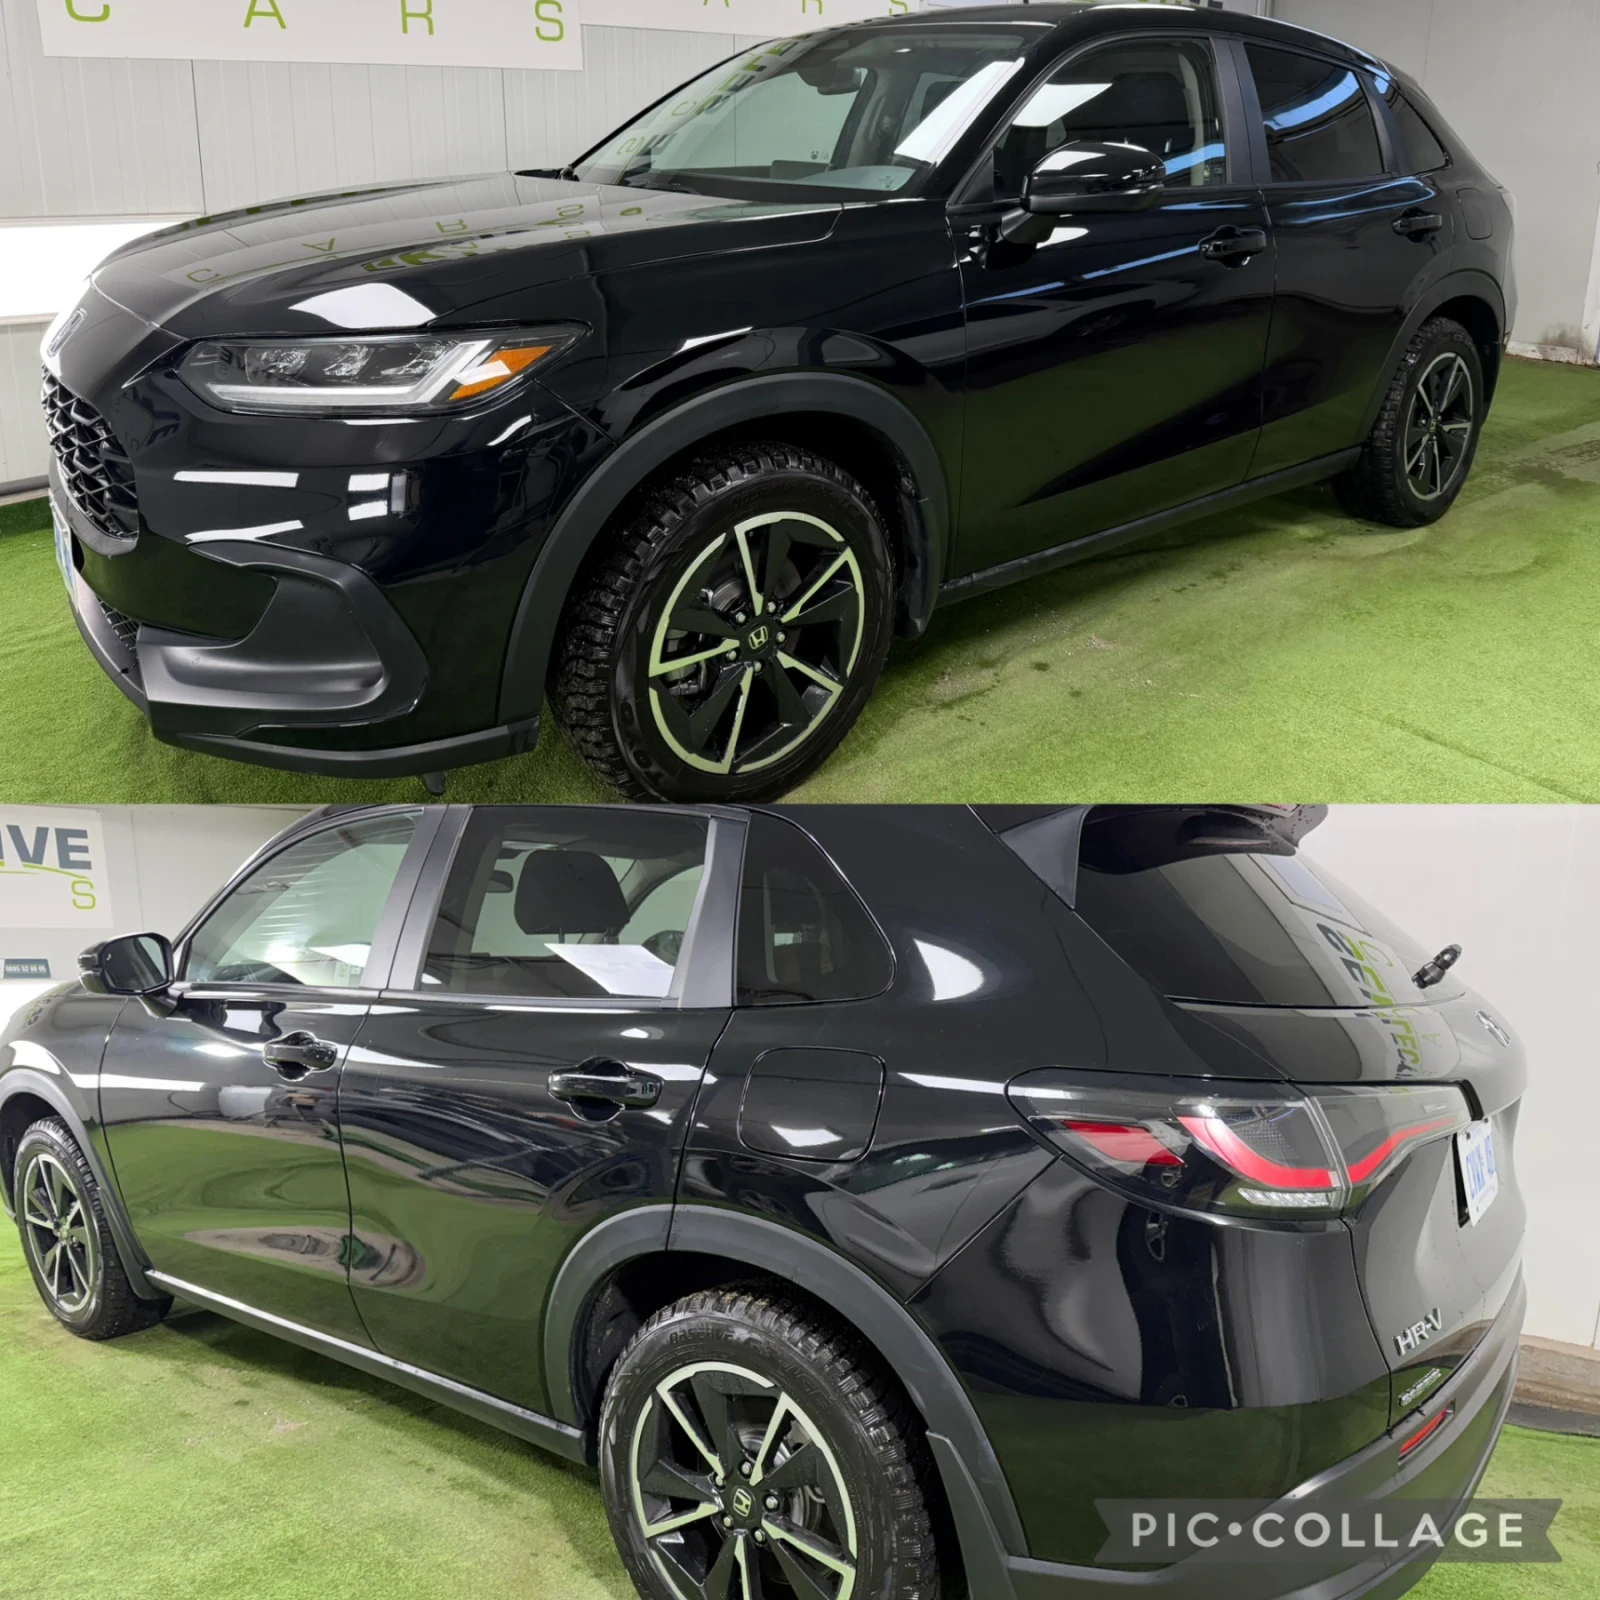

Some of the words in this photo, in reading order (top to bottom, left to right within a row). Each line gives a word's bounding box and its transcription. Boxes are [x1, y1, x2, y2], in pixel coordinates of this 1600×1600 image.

[0, 824, 92, 870] VE
[71, 880, 97, 910] S
[1392, 1307, 1442, 1356] HR-V
